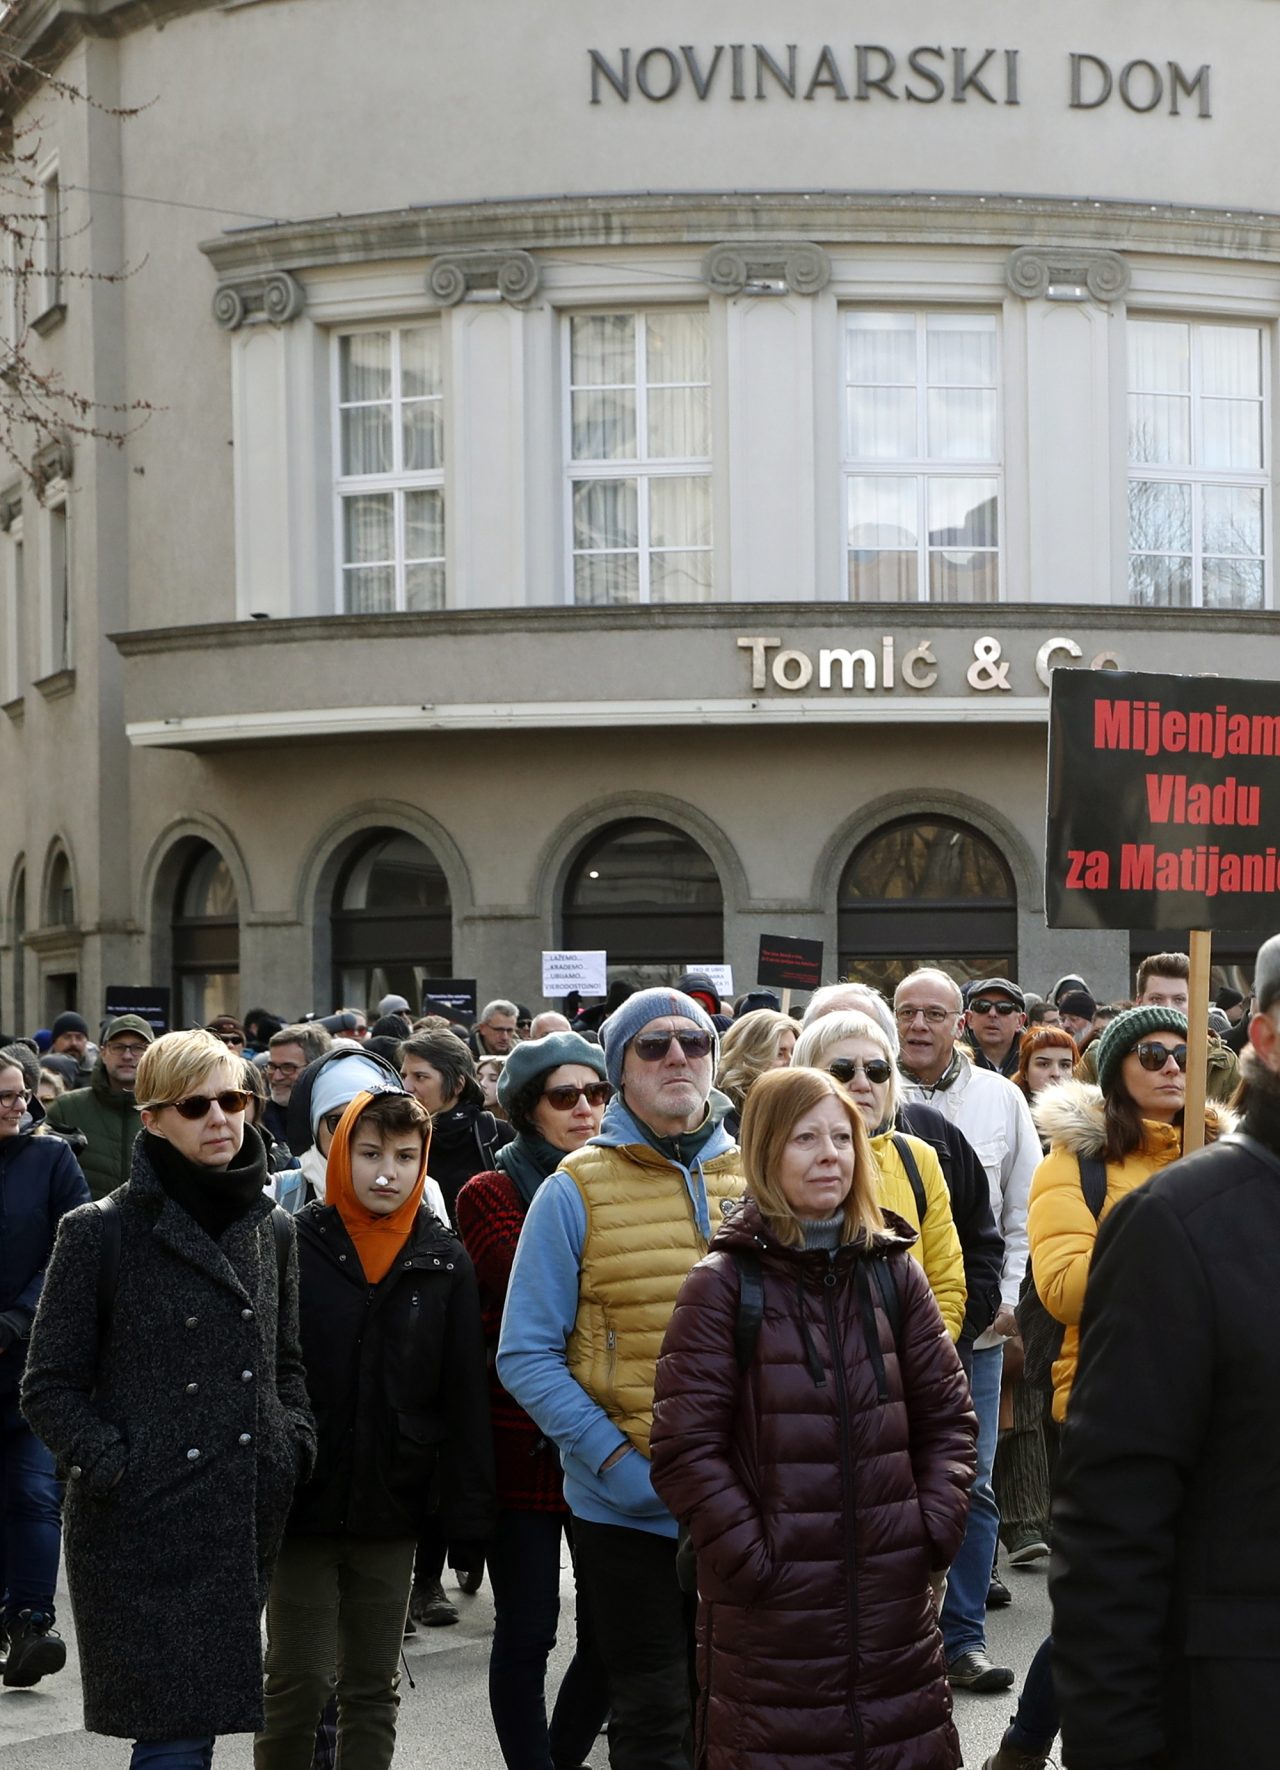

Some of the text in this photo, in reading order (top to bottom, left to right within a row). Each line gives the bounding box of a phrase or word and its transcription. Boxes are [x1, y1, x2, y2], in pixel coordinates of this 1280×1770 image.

[587, 43, 1213, 119] NOVINARSKI DOM
[737, 636, 938, 690] Tomić
[966, 636, 1011, 690] &
[1146, 774, 1260, 827] Vladu
[1065, 849, 1110, 890] za
